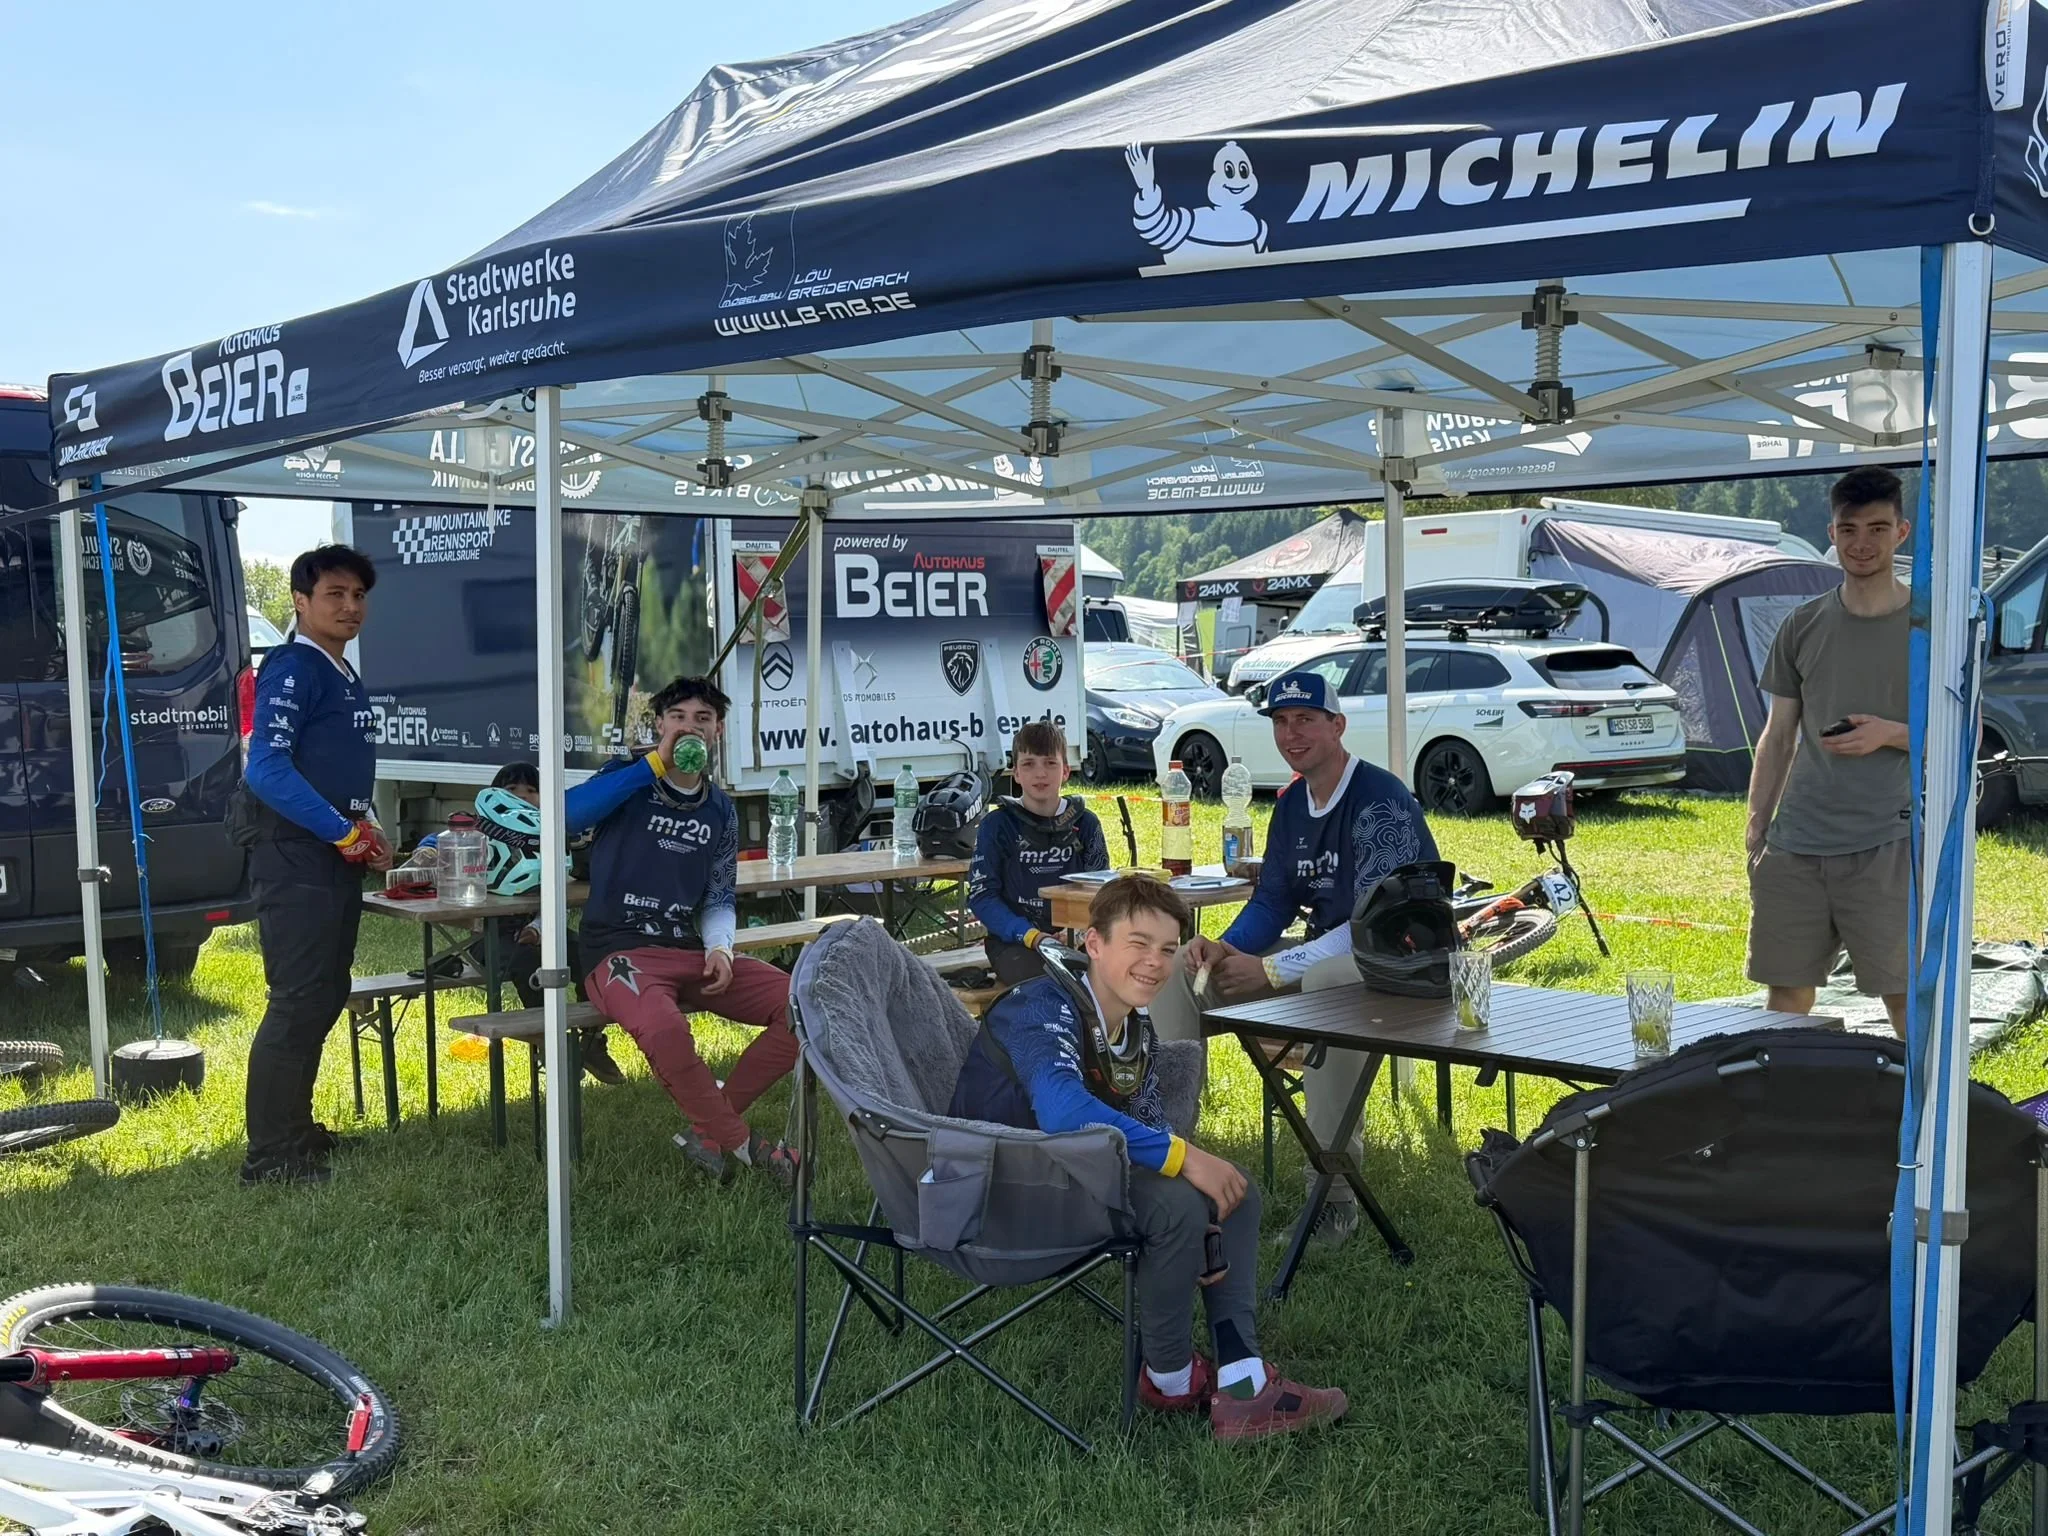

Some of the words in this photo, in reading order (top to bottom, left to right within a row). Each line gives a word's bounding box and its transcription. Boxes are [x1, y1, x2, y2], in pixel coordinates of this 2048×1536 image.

[1286, 81, 1907, 224] MICHELIN
[446, 247, 576, 306] Stadtwerke
[793, 267, 832, 285] LÖW
[467, 286, 577, 337] Karlsruhe
[714, 291, 917, 337] WWW.LB-MB.DE
[218, 323, 284, 357] AUTOHAUS
[418, 366, 447, 383] Besser
[448, 356, 487, 377] versorgt,
[489, 349, 521, 367] weiter
[521, 340, 570, 365] gedacht.
[161, 349, 285, 442] BEIER
[432, 509, 512, 532] MOUNTAINIKE
[431, 531, 495, 551] RENNSPORT
[834, 534, 890, 551] powered
[892, 534, 909, 552] by
[424, 551, 438, 563] 2020
[439, 549, 480, 562] KARLSRUHE
[913, 552, 986, 569] AUTOHAUS
[834, 553, 990, 619] BEIER
[1198, 581, 1240, 597] 24MX
[1266, 575, 1312, 591] 24MX
[943, 644, 976, 652] PEUGEOT
[1023, 641, 1037, 665] ALFA
[1039, 638, 1062, 665] ROMEO
[389, 694, 396, 705] by
[130, 705, 228, 725] stadtmobil
[397, 705, 427, 716] AUTOHAUS
[1476, 709, 1505, 717] SCHLEIFF
[180, 722, 229, 730] carsharing
[371, 705, 429, 746] BEIER
[647, 814, 712, 845] mr20
[1019, 846, 1073, 864] mr20
[1553, 883, 1572, 907] 42
